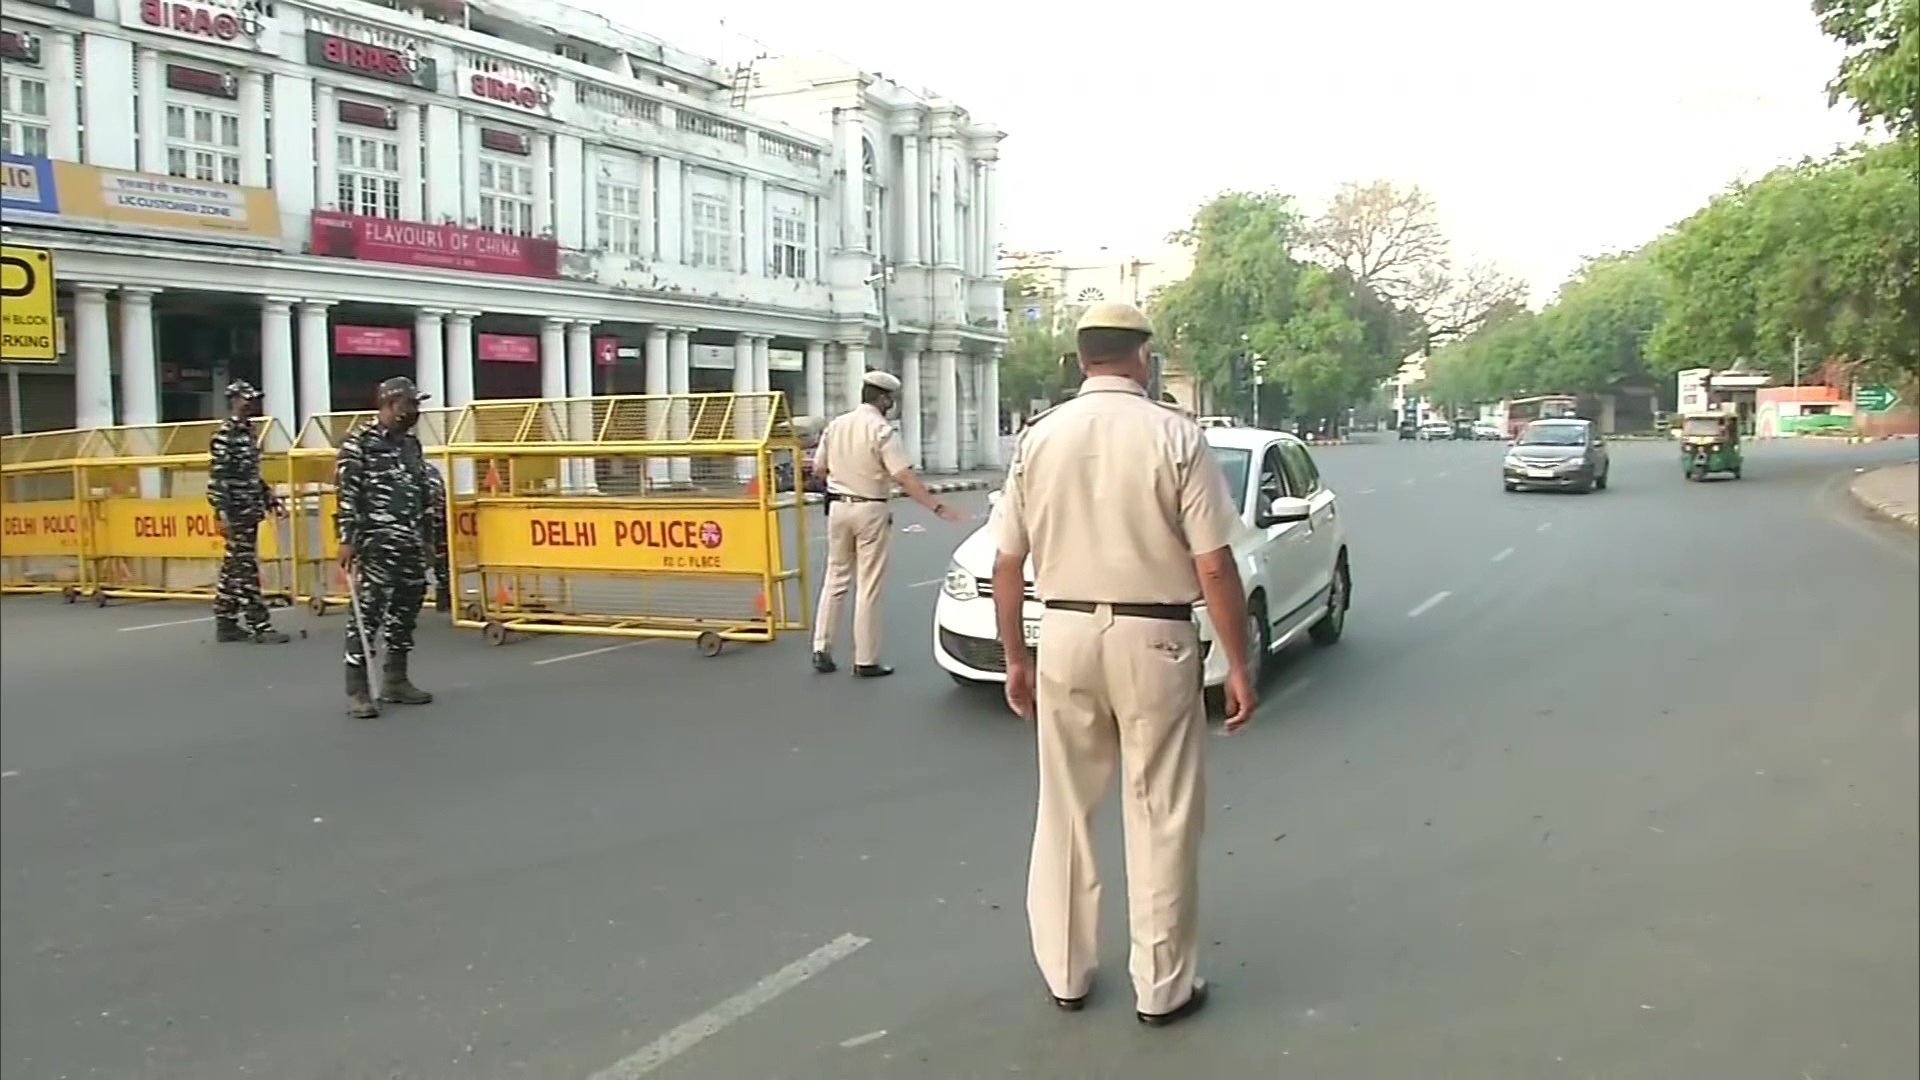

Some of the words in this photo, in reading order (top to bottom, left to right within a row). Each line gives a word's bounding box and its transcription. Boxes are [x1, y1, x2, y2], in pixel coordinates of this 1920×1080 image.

[200, 204, 231, 217] ZONE
[450, 232, 468, 250] OF
[476, 236, 520, 256] CHINA
[13, 315, 48, 325] BLOCK
[1, 335, 49, 348] RKING
[5, 517, 36, 536] DELHI
[135, 516, 176, 538] DELHI
[530, 519, 597, 547] DELHI
[614, 519, 698, 549] POLICE
